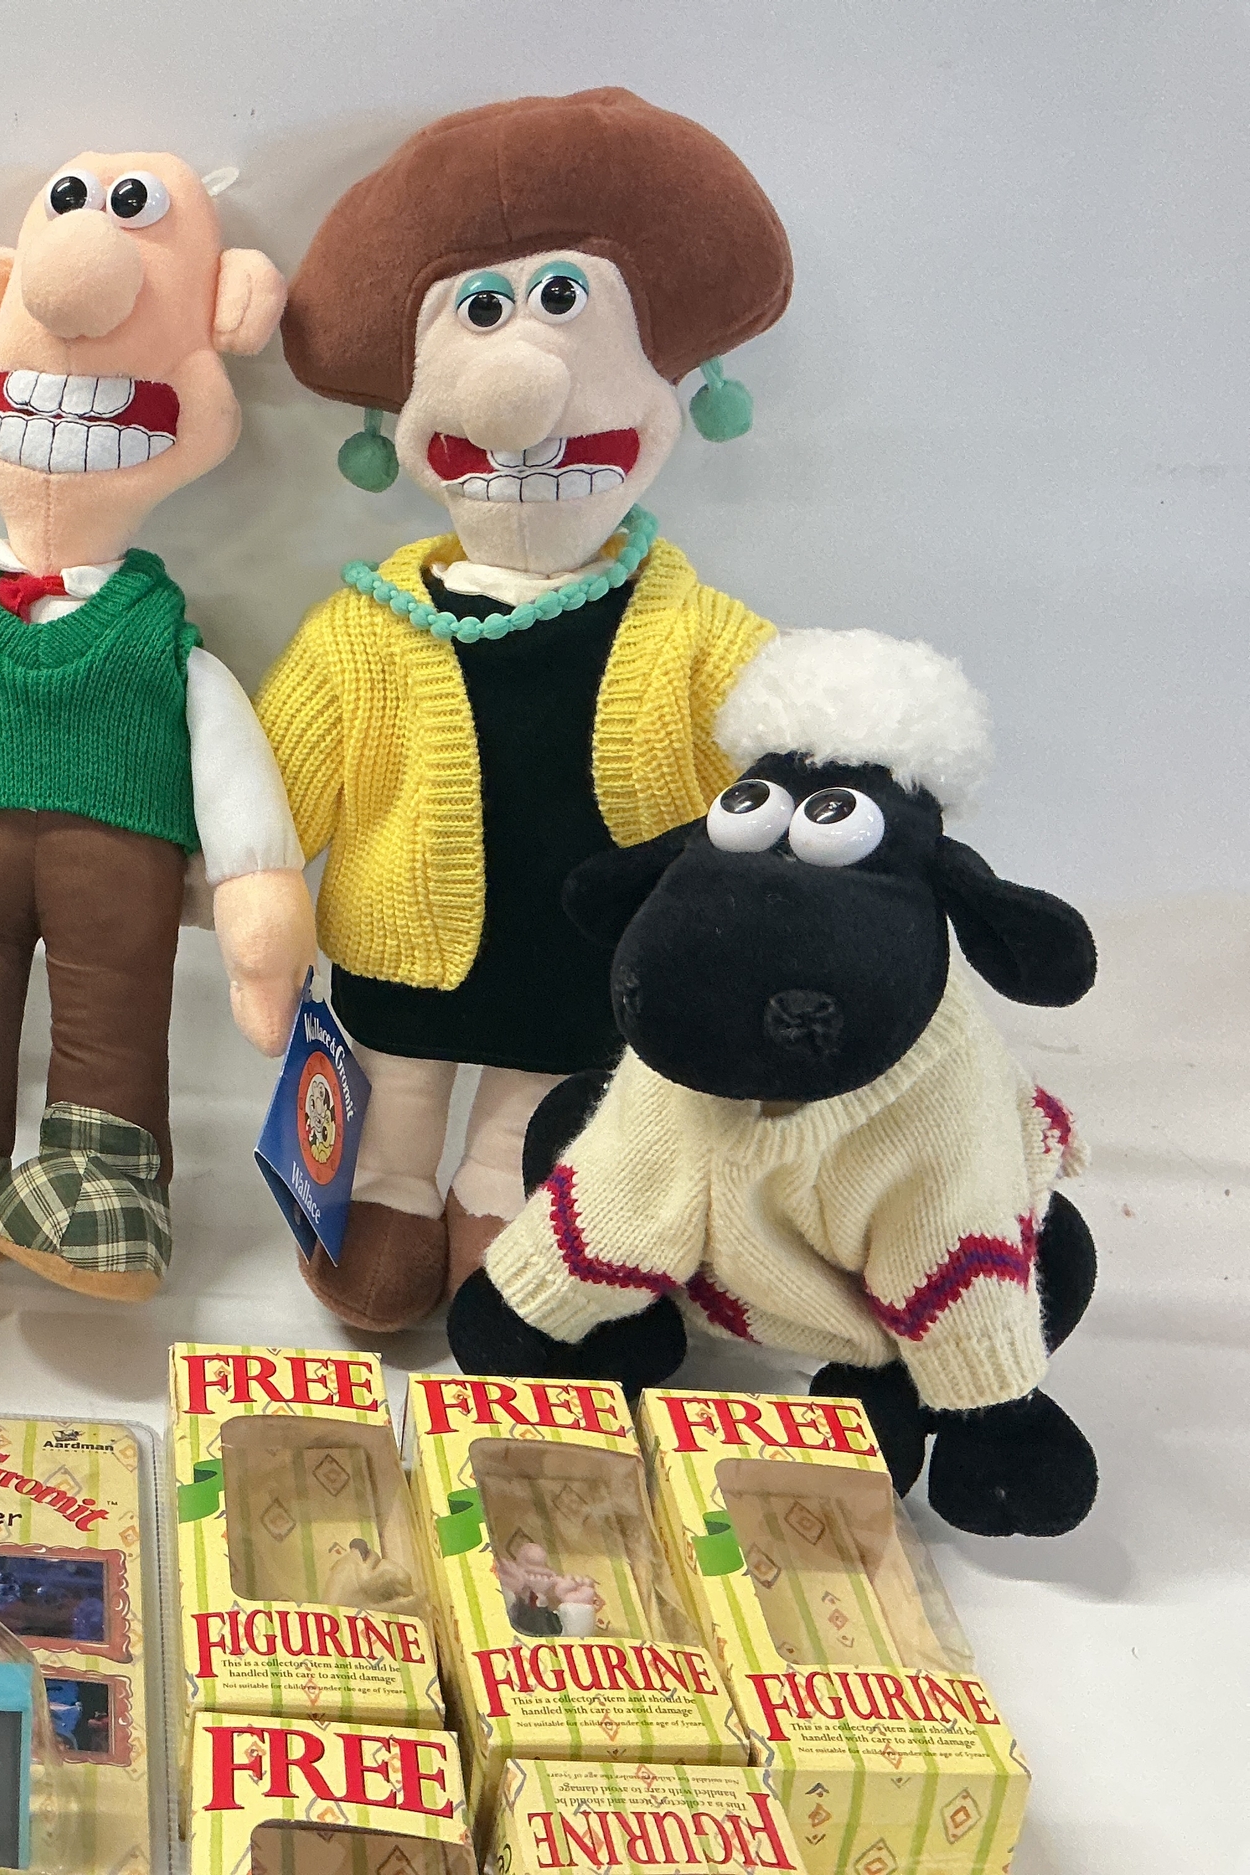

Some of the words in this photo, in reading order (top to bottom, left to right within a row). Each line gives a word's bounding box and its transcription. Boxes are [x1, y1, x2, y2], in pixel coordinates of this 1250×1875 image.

[304, 1012, 331, 1048] Wallace
[335, 1045, 354, 1121] Gromit
[291, 1161, 322, 1224] Wallace
[180, 1354, 379, 1415] FREE
[417, 1379, 627, 1437] FREE
[657, 1396, 878, 1457] FREE
[43, 1440, 114, 1452] Aardman
[191, 1609, 426, 1678] FIGURINE
[221, 1660, 241, 1668] This
[243, 1660, 252, 1668] is
[310, 1660, 332, 1670] item
[334, 1661, 352, 1670] and
[354, 1661, 384, 1672] should
[388, 1664, 401, 1673] be
[229, 1670, 269, 1678] handled
[270, 1670, 294, 1679] with
[296, 1672, 316, 1680] care
[318, 1672, 329, 1680] to
[330, 1670, 357, 1681] avoid
[358, 1672, 396, 1685] damage
[471, 1643, 719, 1718] FIGURINE
[222, 1682, 236, 1690] Not
[238, 1682, 270, 1690] suitable
[512, 1696, 533, 1706] This
[535, 1697, 543, 1705] is
[603, 1696, 626, 1704] item
[628, 1695, 647, 1704] and
[648, 1695, 682, 1705] should
[685, 1696, 696, 1705] be
[744, 1671, 1001, 1741] FIGURINE
[521, 1706, 562, 1716] handled
[564, 1706, 588, 1716] with
[591, 1708, 610, 1716] care
[613, 1706, 624, 1716] to
[626, 1705, 652, 1715] avoid
[655, 1705, 694, 1718] damage
[791, 1723, 812, 1732] This
[814, 1724, 822, 1732] is
[824, 1724, 830, 1732] a
[884, 1724, 906, 1734] item
[909, 1724, 927, 1734] and
[929, 1725, 962, 1735] should
[966, 1726, 978, 1736] be
[802, 1733, 842, 1743] handled
[845, 1734, 868, 1744] with
[871, 1736, 892, 1744] care
[894, 1736, 906, 1744] to
[908, 1736, 934, 1746] avoid
[937, 1736, 976, 1749] damage
[202, 1726, 454, 1819] FREE
[558, 1784, 598, 1795] damage
[600, 1786, 628, 1796] avoid
[631, 1786, 642, 1796] to
[645, 1786, 666, 1796] care
[668, 1787, 692, 1798] with
[694, 1789, 736, 1800] handled
[554, 1796, 566, 1806] be
[570, 1796, 604, 1806] should
[606, 1796, 626, 1806] and
[629, 1796, 652, 1806] item
[706, 1800, 713, 1808] a
[715, 1800, 724, 1810] is
[727, 1800, 747, 1812] This
[527, 1791, 797, 1871] FIGURINE
